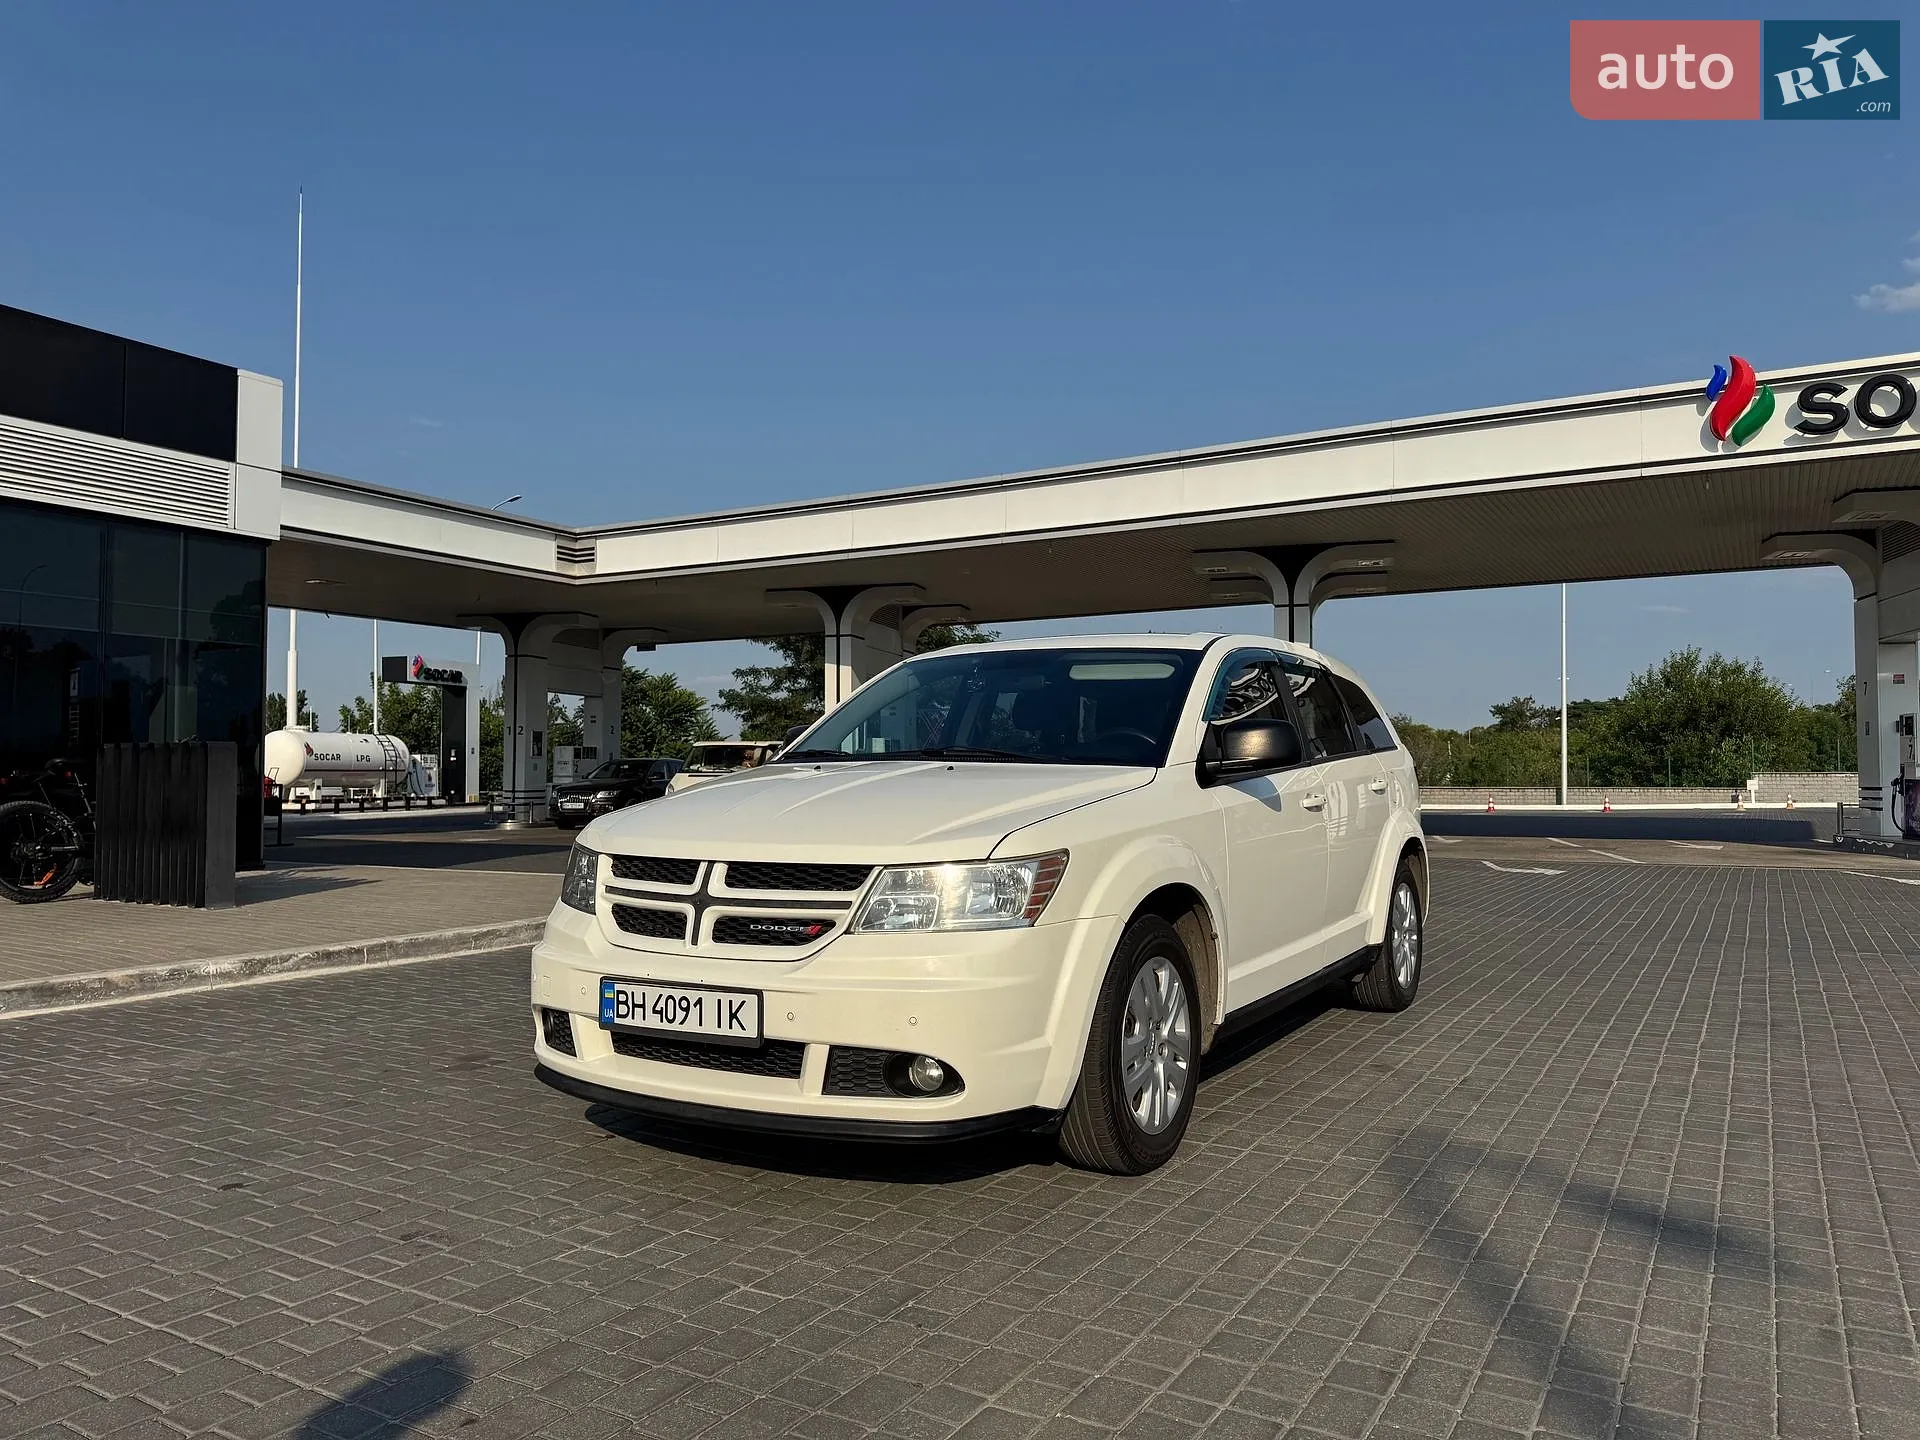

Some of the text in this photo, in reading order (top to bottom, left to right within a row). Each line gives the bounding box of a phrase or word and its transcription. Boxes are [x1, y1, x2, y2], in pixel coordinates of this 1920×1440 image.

[506, 726, 512, 736] 1
[517, 725, 525, 736] 2
[313, 752, 371, 763] SOCAR LPG
[604, 1008, 614, 1018] UA
[615, 989, 747, 1031] BH 4091 IK
